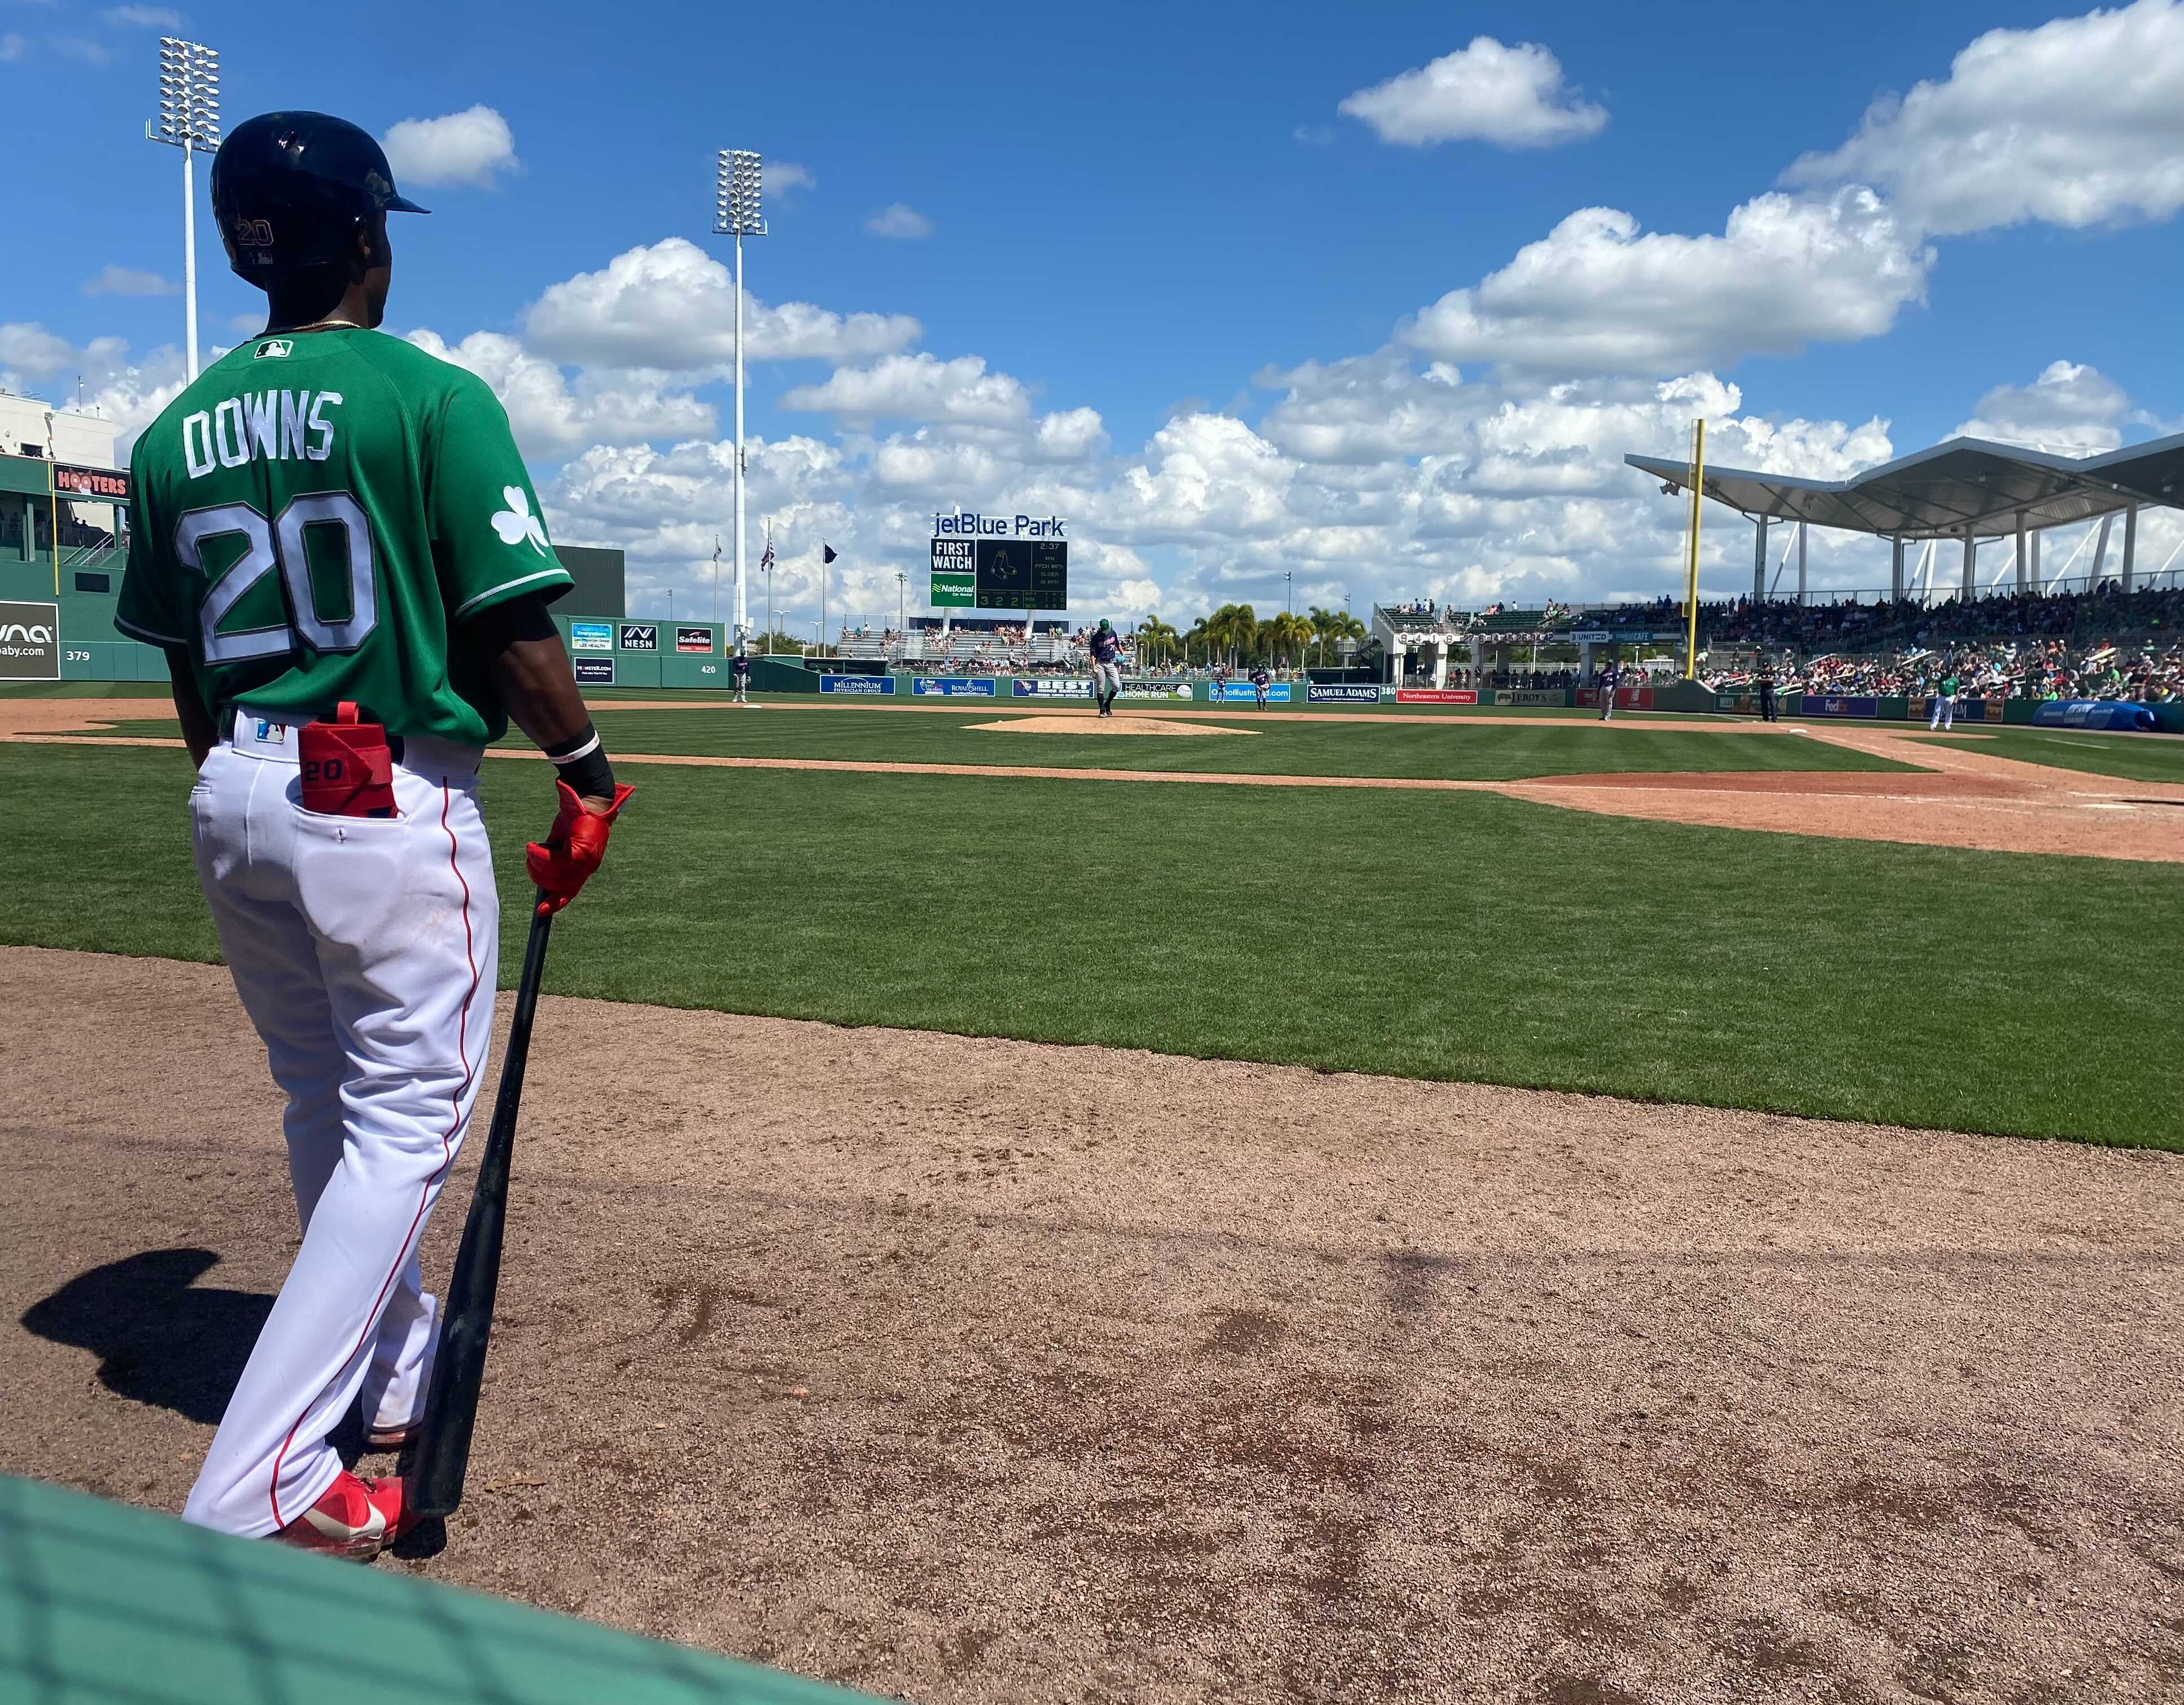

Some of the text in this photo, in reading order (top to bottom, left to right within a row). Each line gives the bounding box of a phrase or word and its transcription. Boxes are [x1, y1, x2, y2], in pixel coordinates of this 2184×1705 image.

[235, 219, 274, 246] 20
[182, 390, 343, 479] DOWNS
[58, 471, 126, 495] HOOTERS
[934, 513, 1064, 537] jetBlue Park
[936, 542, 970, 556] FIRST
[933, 556, 972, 570] WATCH
[171, 489, 379, 667] 20
[941, 584, 974, 593] National
[980, 596, 989, 606] 3
[995, 596, 1003, 606] 2
[1011, 597, 1019, 606] 2
[1401, 634, 1407, 642] 9
[1416, 634, 1422, 642] 4
[1432, 635, 1436, 643] 1
[1544, 633, 1554, 642] 42
[624, 639, 653, 649] NESN
[0, 644, 45, 657] aby.com
[66, 650, 90, 661] 379
[834, 680, 881, 689] MILLENNIUM
[1037, 680, 1090, 689] BEST
[1125, 684, 1177, 692] HEALTHCARE
[1310, 688, 1377, 698] SAMUEL ADAMS
[1381, 687, 1396, 695] 380
[1511, 692, 1547, 703] LEROY'S
[305, 758, 342, 782] 20
